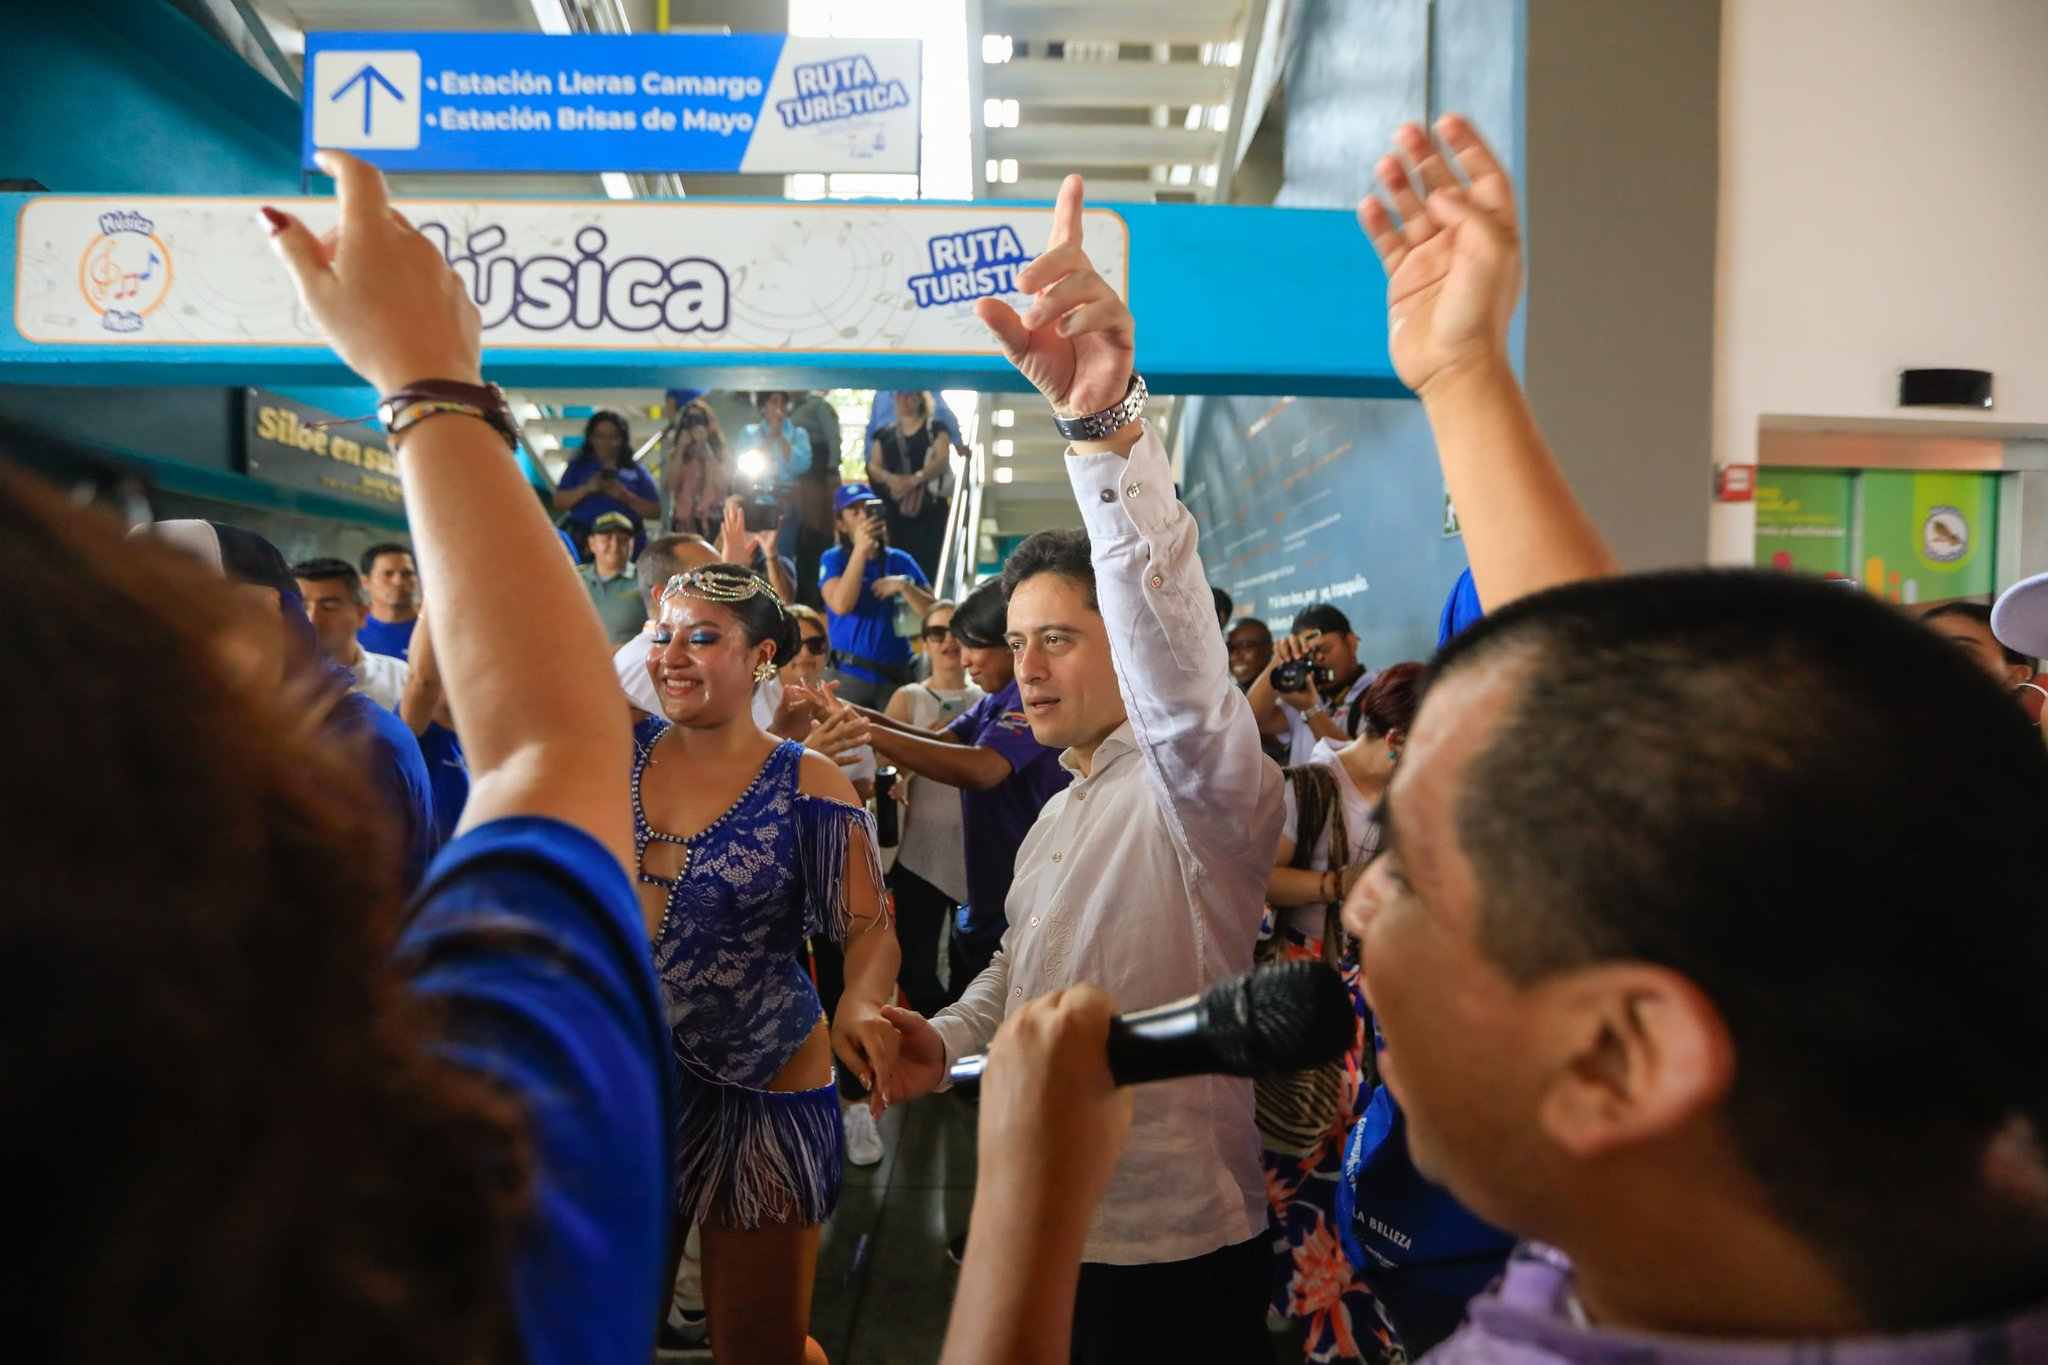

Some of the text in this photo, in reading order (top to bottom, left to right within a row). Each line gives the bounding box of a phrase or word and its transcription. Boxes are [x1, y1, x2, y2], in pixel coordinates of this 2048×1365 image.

[440, 70, 763, 101] Estación Lleras Camargo
[796, 57, 875, 96] RUTA
[439, 105, 754, 137] Estación Brisas de Mayo
[778, 81, 908, 127] TURÍSTICA
[930, 226, 1022, 271] RUTA
[1369, 1215, 1412, 1251] BELLEZA
